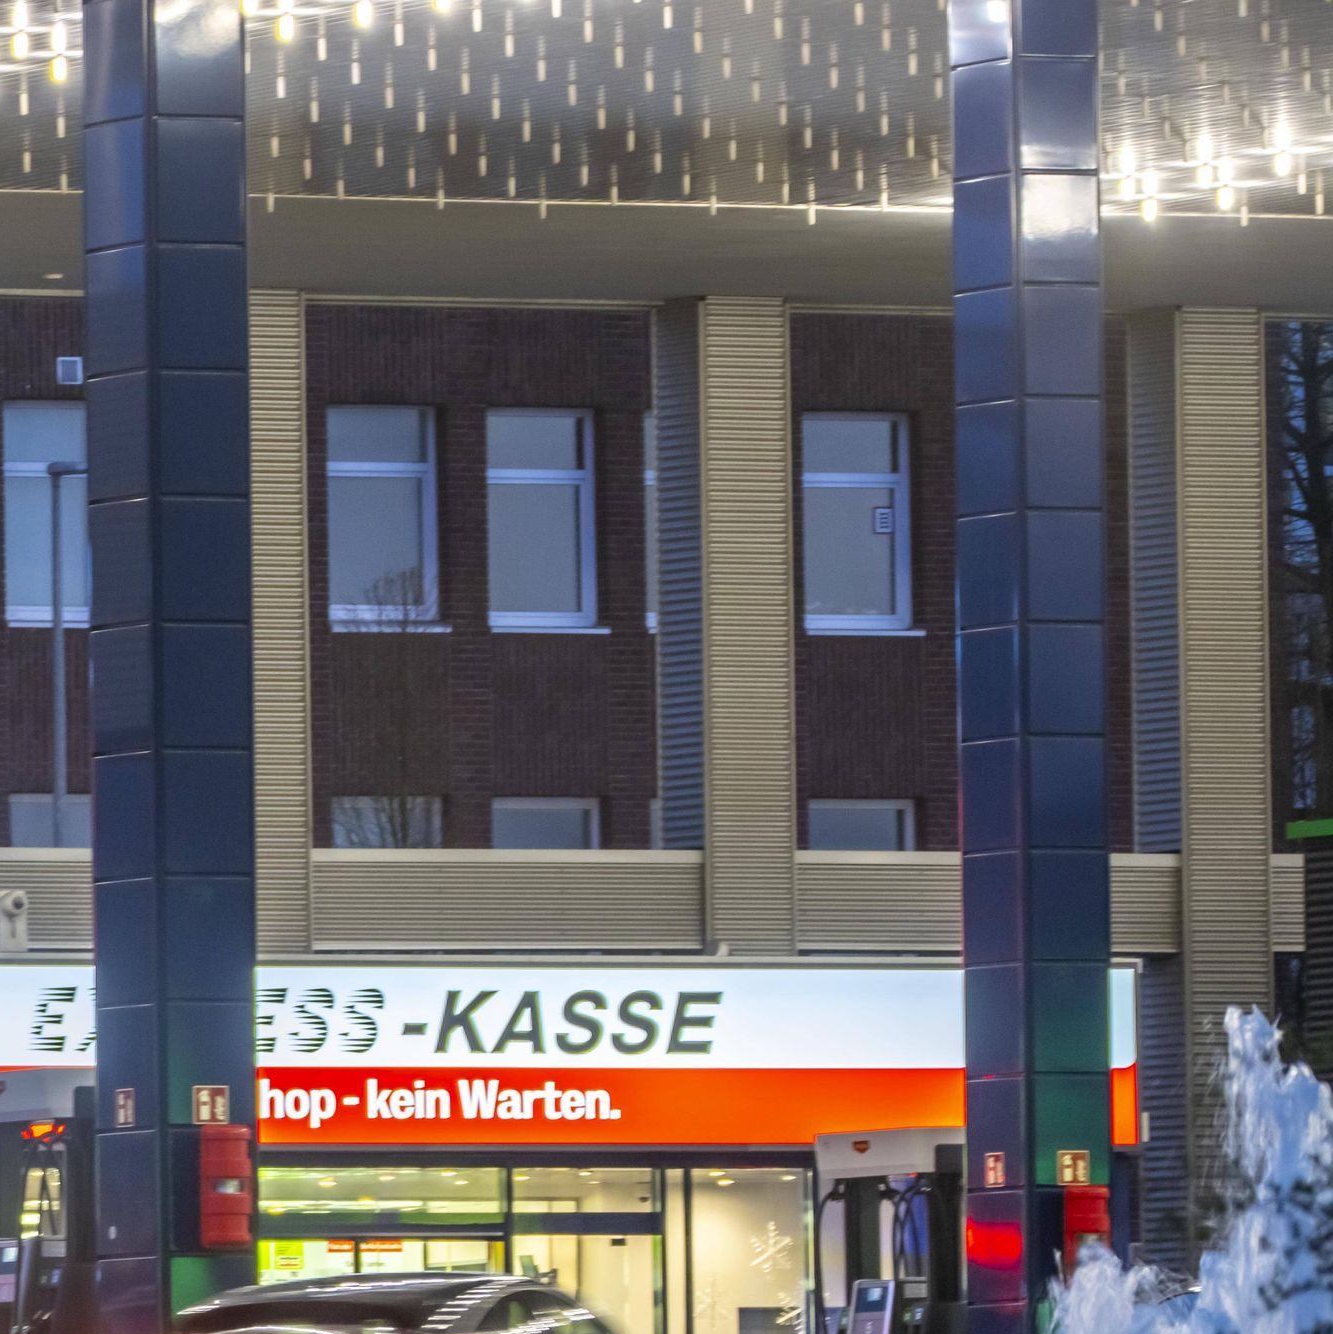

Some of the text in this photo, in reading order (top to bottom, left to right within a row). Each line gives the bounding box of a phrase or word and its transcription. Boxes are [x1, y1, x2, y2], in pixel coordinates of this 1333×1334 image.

[258, 1078, 337, 1129] hop
[366, 1078, 451, 1120] kein
[457, 1078, 622, 1121] Warten.
